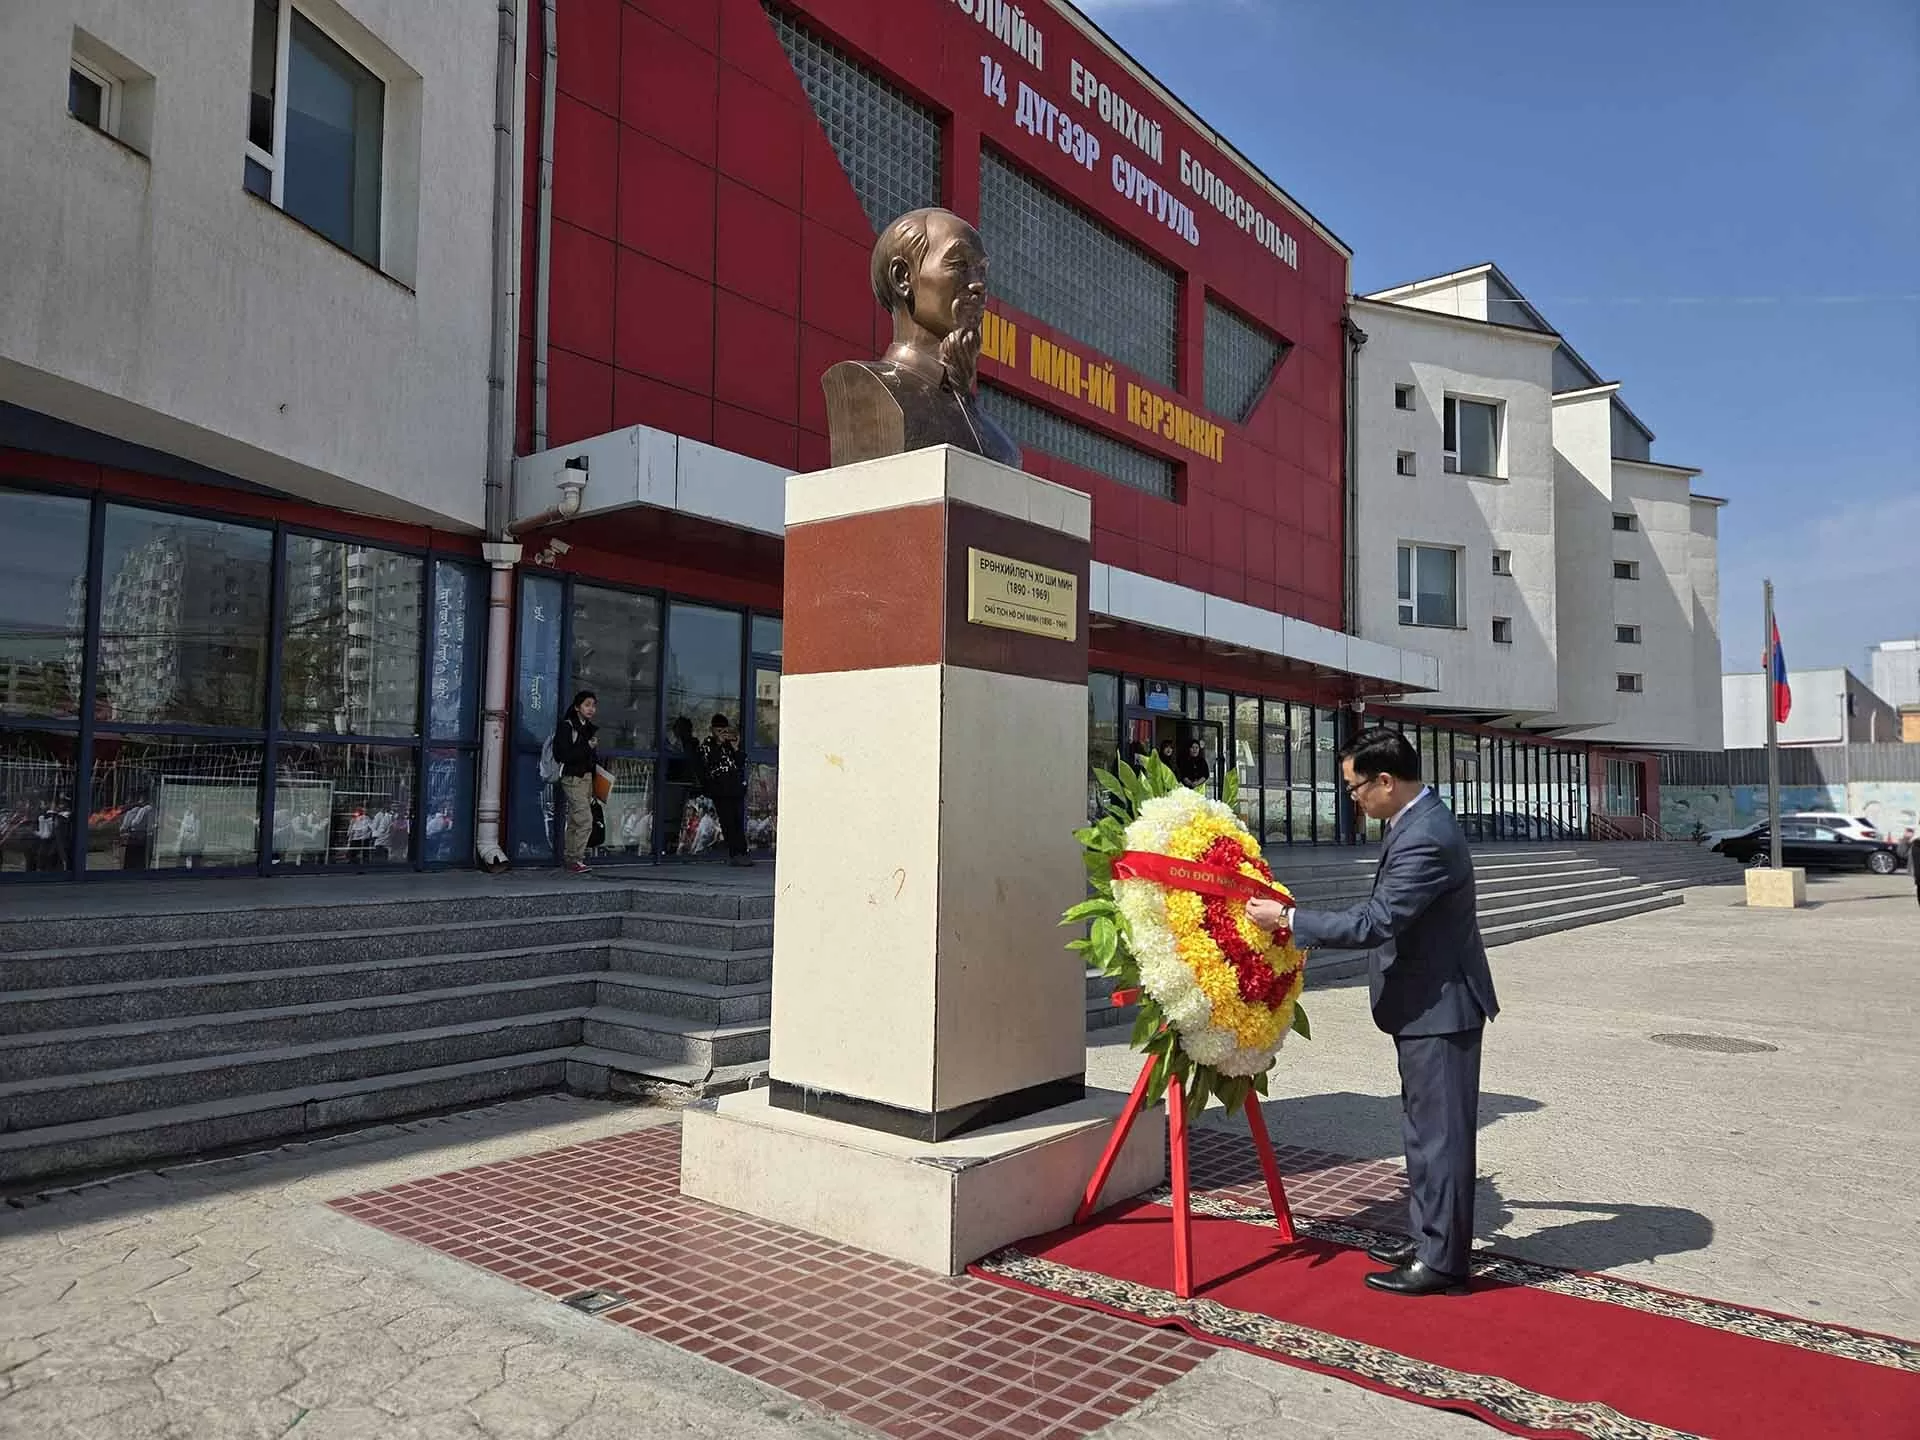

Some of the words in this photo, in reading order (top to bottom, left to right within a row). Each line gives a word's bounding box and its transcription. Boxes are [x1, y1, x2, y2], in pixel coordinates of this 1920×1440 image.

[980, 55, 1007, 108] 14
[1015, 81, 1100, 172] ДҮГЭЭР
[1112, 154, 1200, 247] СУРГУУЛЬ
[1070, 58, 1163, 165] ЕРӨНХИЙ
[1180, 149, 1298, 272] БОЛОВСРОЛЫН
[1031, 334, 1116, 415] МИН-ИЙ
[1127, 382, 1225, 464] НЭРЭМЖИТ
[980, 558, 1034, 580] ЕРӨНХИЙЛӨГЧ
[1035, 572, 1045, 584] ХО
[1045, 575, 1057, 587] ШИ
[1057, 577, 1073, 591] МИН
[1006, 581, 1026, 596] (1890
[1032, 587, 1050, 604] 1969)
